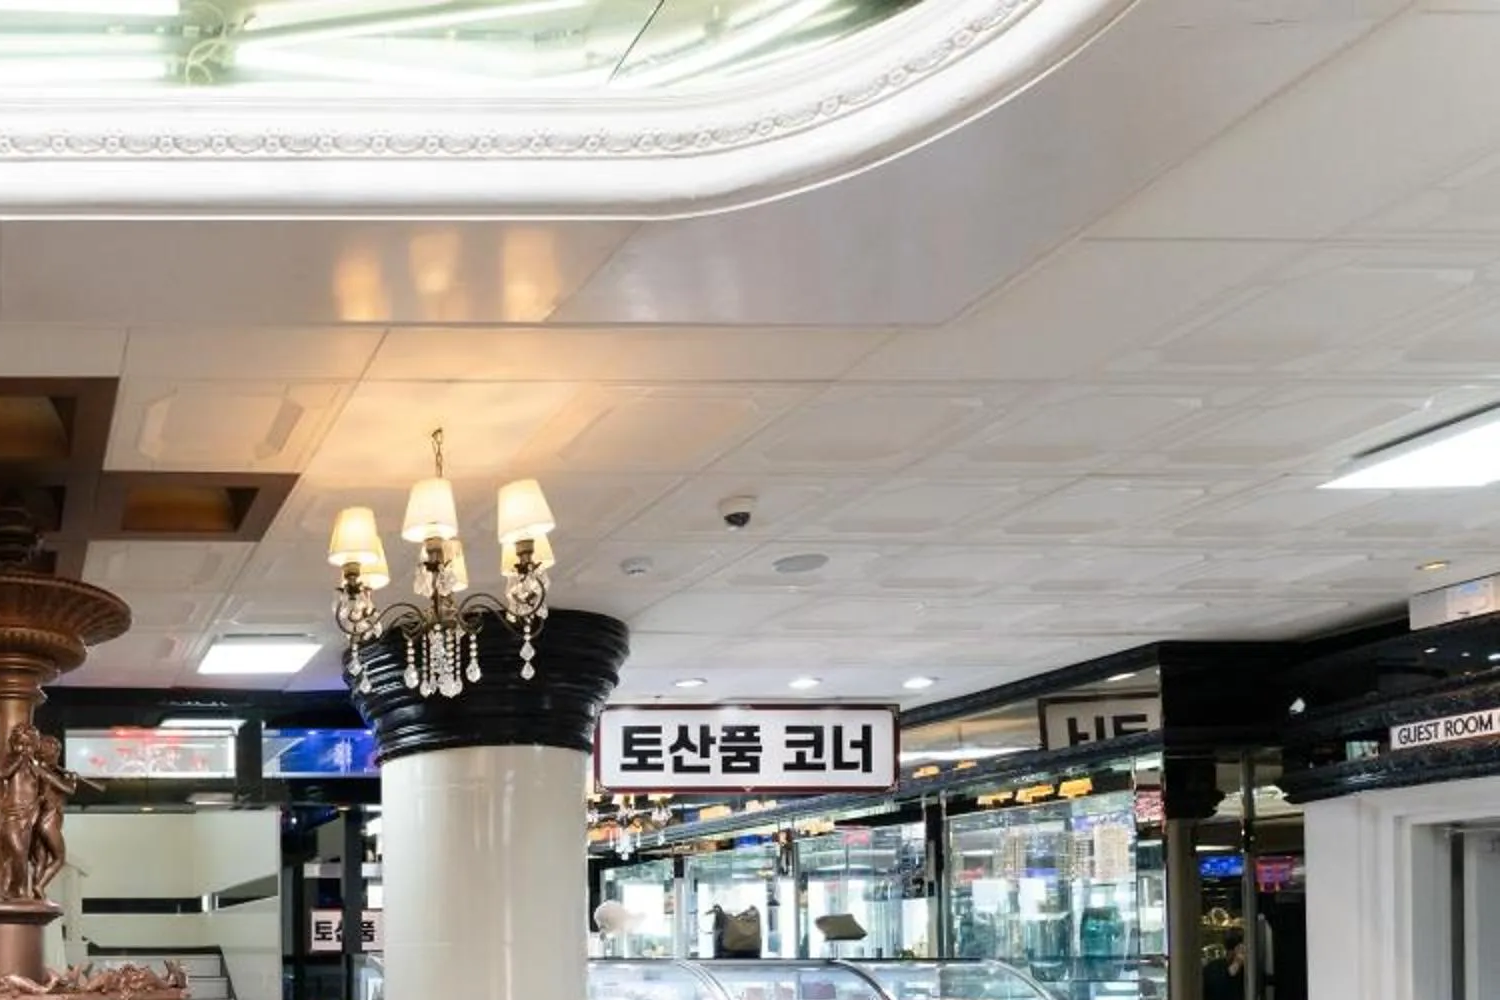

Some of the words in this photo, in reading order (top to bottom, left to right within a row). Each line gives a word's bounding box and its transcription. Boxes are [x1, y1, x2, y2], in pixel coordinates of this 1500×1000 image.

[620, 724, 763, 774] 토산품
[783, 724, 873, 774] 코너
[1398, 722, 1440, 745] GUEST
[1444, 712, 1493, 737] ROOM
